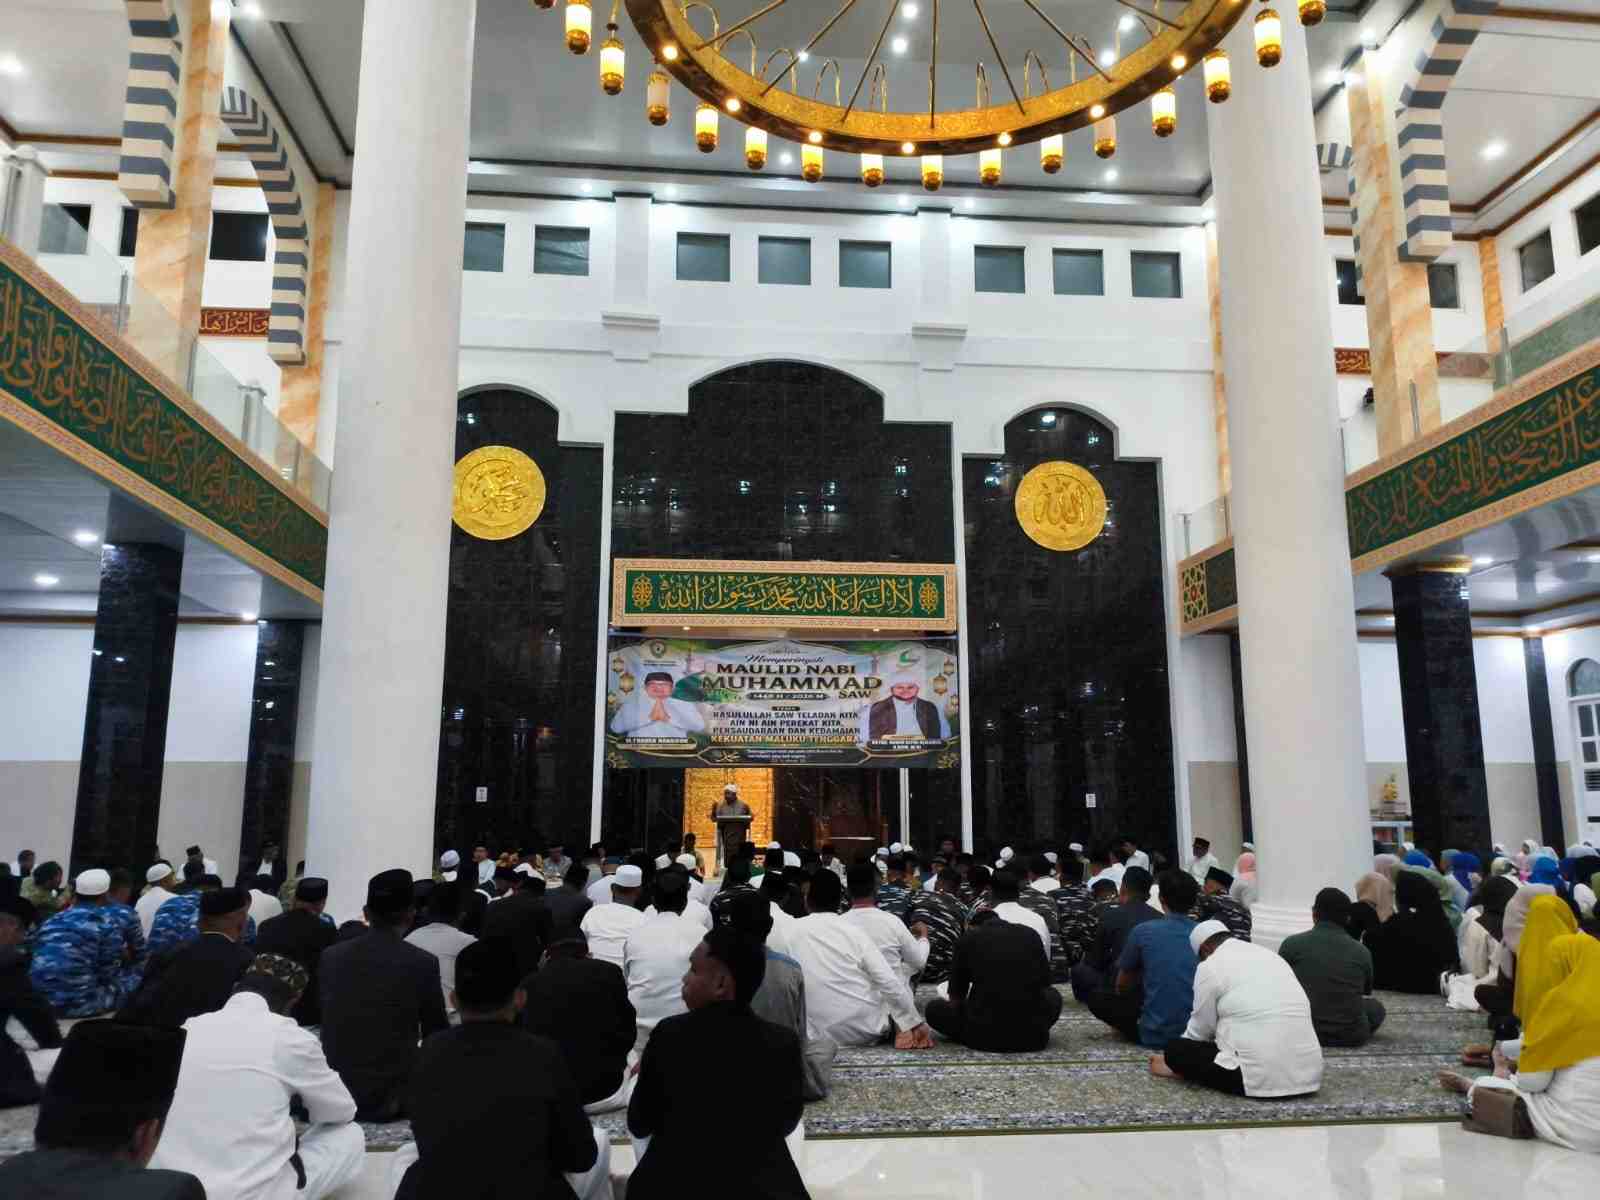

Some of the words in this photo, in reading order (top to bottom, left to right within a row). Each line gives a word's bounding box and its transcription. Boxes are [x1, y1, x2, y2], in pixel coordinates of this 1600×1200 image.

[717, 663, 798, 675] MAULID
[806, 664, 856, 675] NABI
[702, 676, 882, 690] MUHAMMAD
[838, 690, 872, 699] SAW
[713, 711, 771, 719] RASULULLAH
[774, 711, 794, 719] SAW
[798, 711, 836, 719] TELADAN
[780, 719, 818, 727] PEREKAT
[711, 735, 762, 743] KEKUATAN
[766, 735, 806, 743] MALUKU
